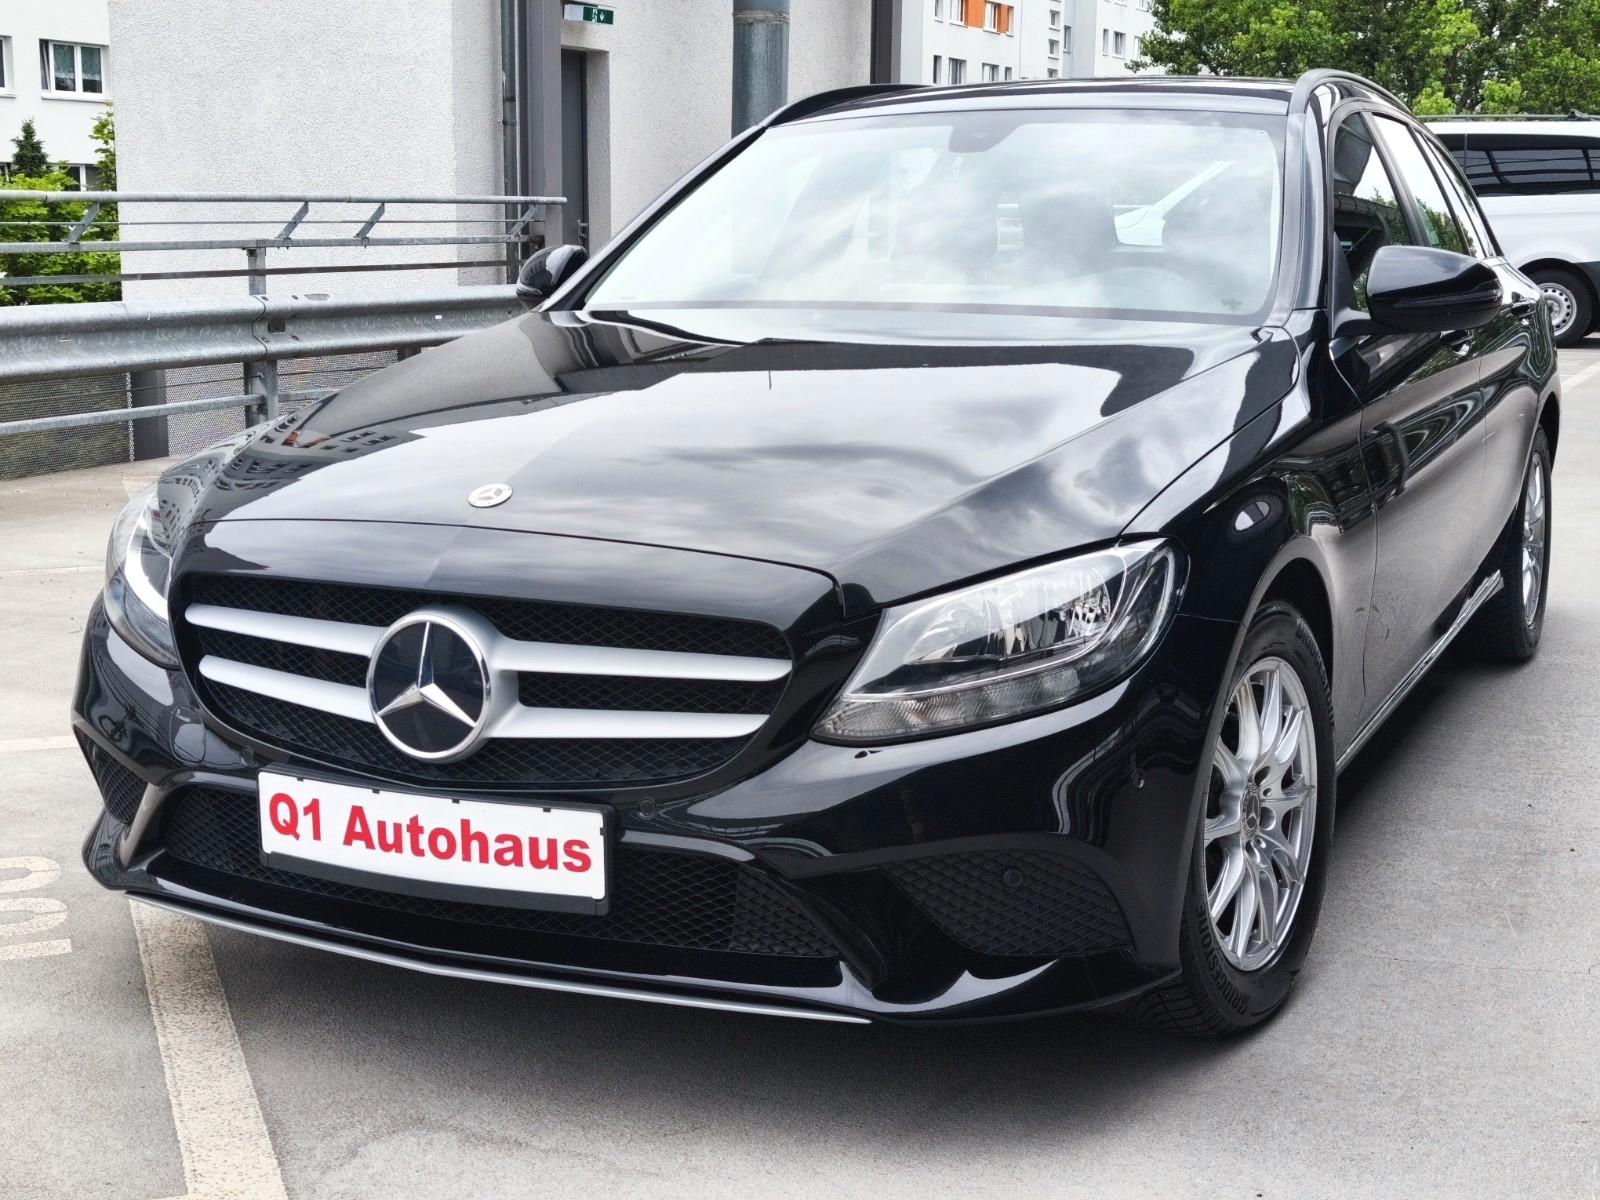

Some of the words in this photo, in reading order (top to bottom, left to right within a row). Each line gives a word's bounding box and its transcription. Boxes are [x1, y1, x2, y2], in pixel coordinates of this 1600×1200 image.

[268, 792, 322, 841] Q1
[343, 804, 593, 874] Autohaus
[1197, 904, 1251, 1016] BRIDGESTONE
